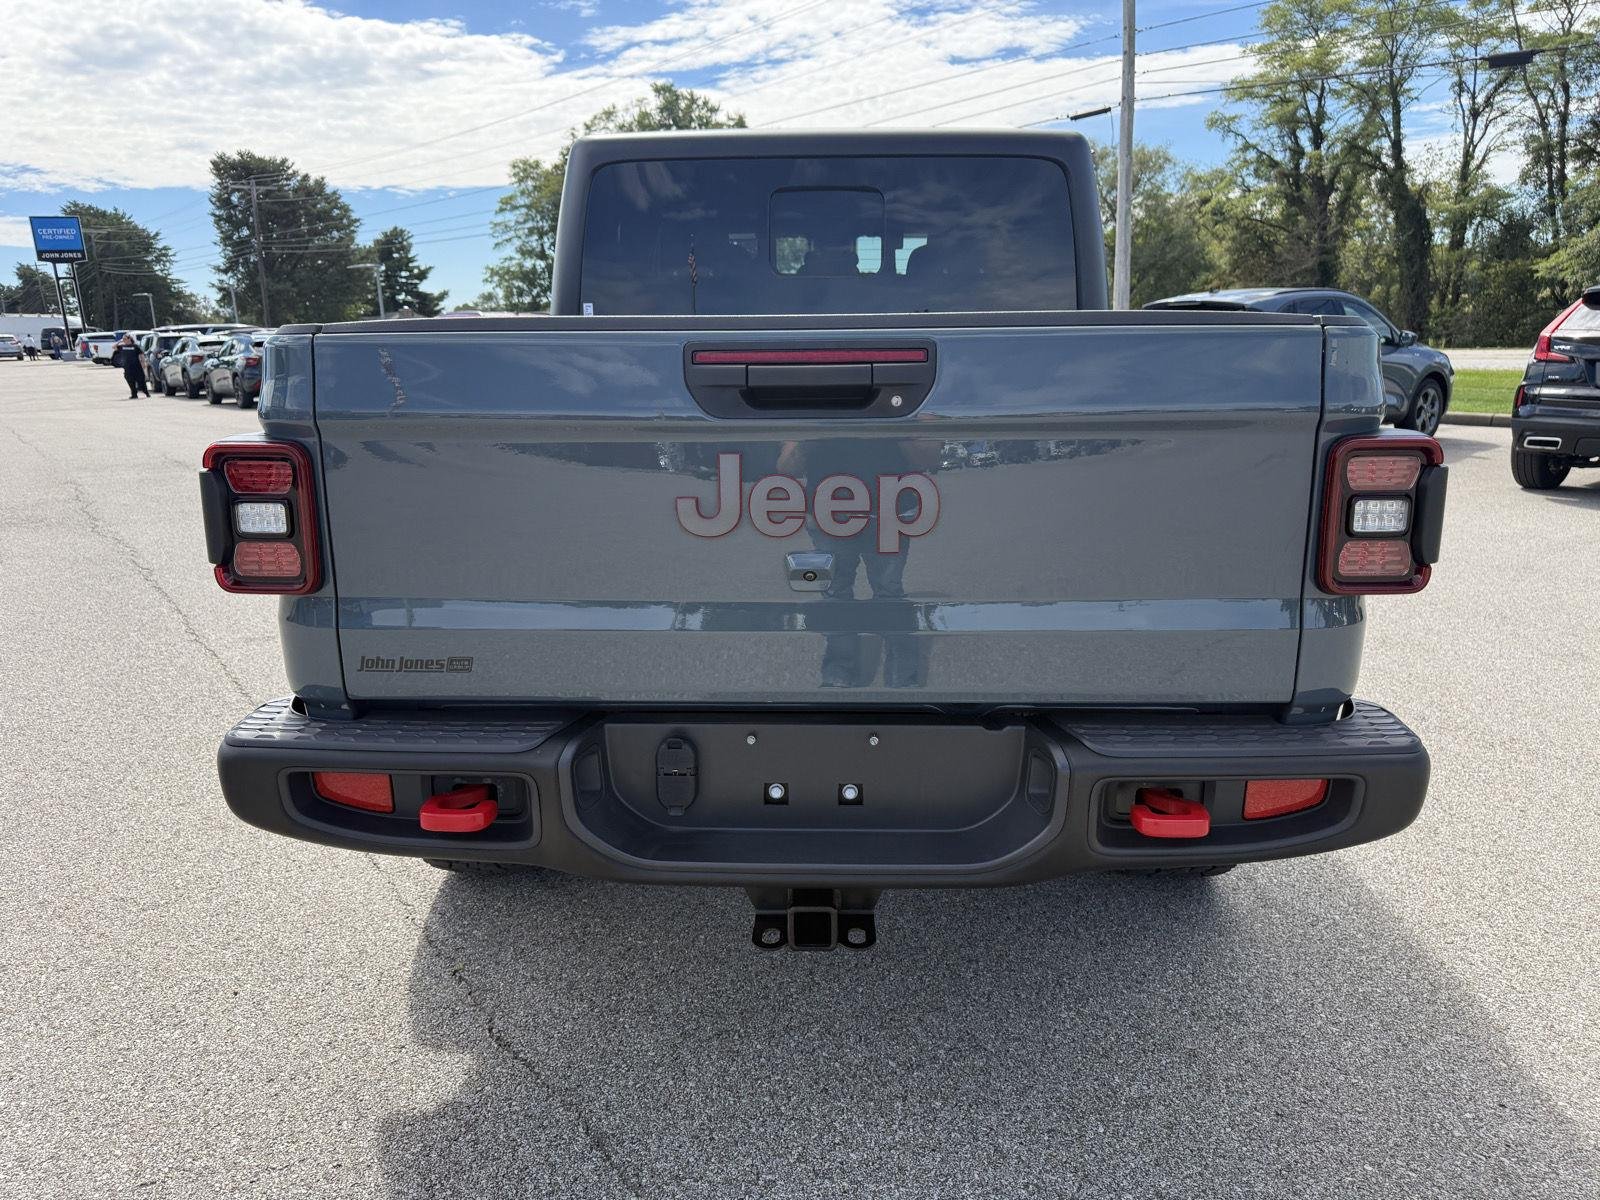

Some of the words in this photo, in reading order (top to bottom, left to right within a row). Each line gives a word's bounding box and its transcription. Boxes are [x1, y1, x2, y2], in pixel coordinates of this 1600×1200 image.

[676, 451, 941, 554] Jeep
[357, 655, 395, 672] John
[395, 655, 446, 672] Jones
